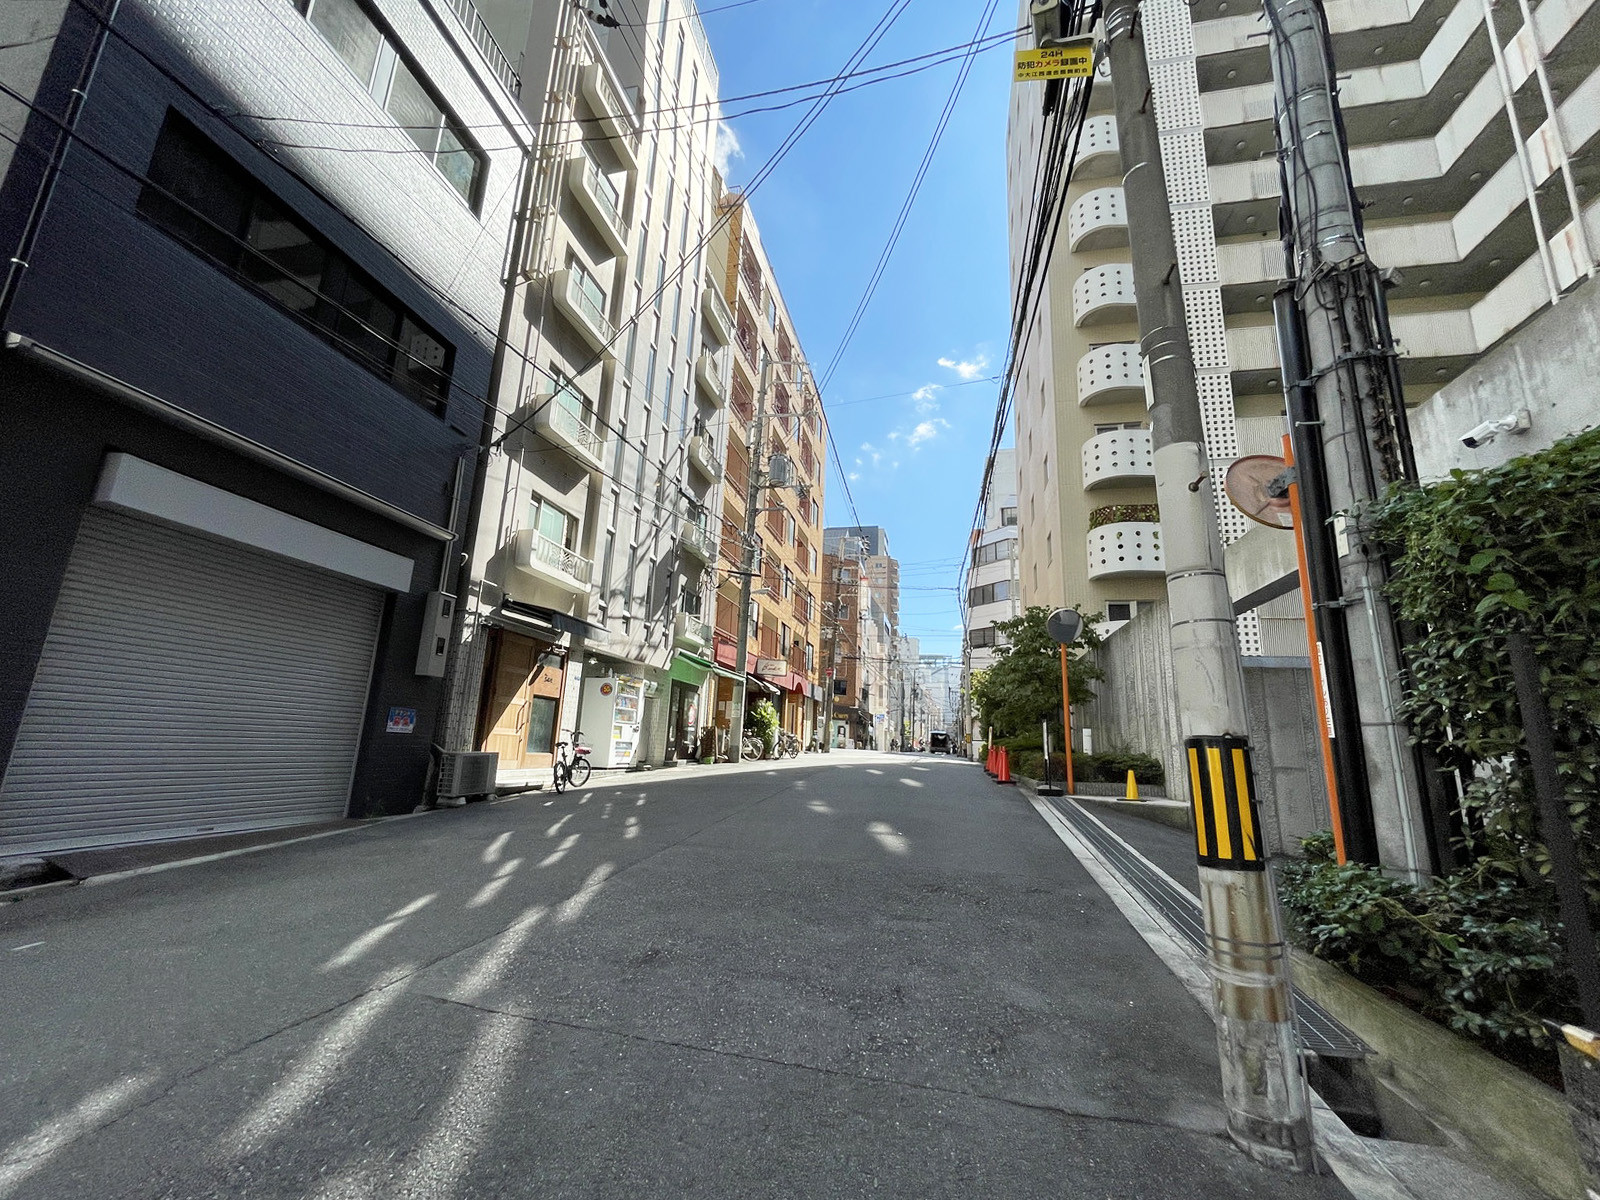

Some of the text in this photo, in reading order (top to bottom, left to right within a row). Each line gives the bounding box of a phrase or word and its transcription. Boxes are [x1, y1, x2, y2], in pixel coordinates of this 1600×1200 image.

[1041, 50, 1063, 58] 24H
[1017, 57, 1088, 70] 防犯カメラ録画中
